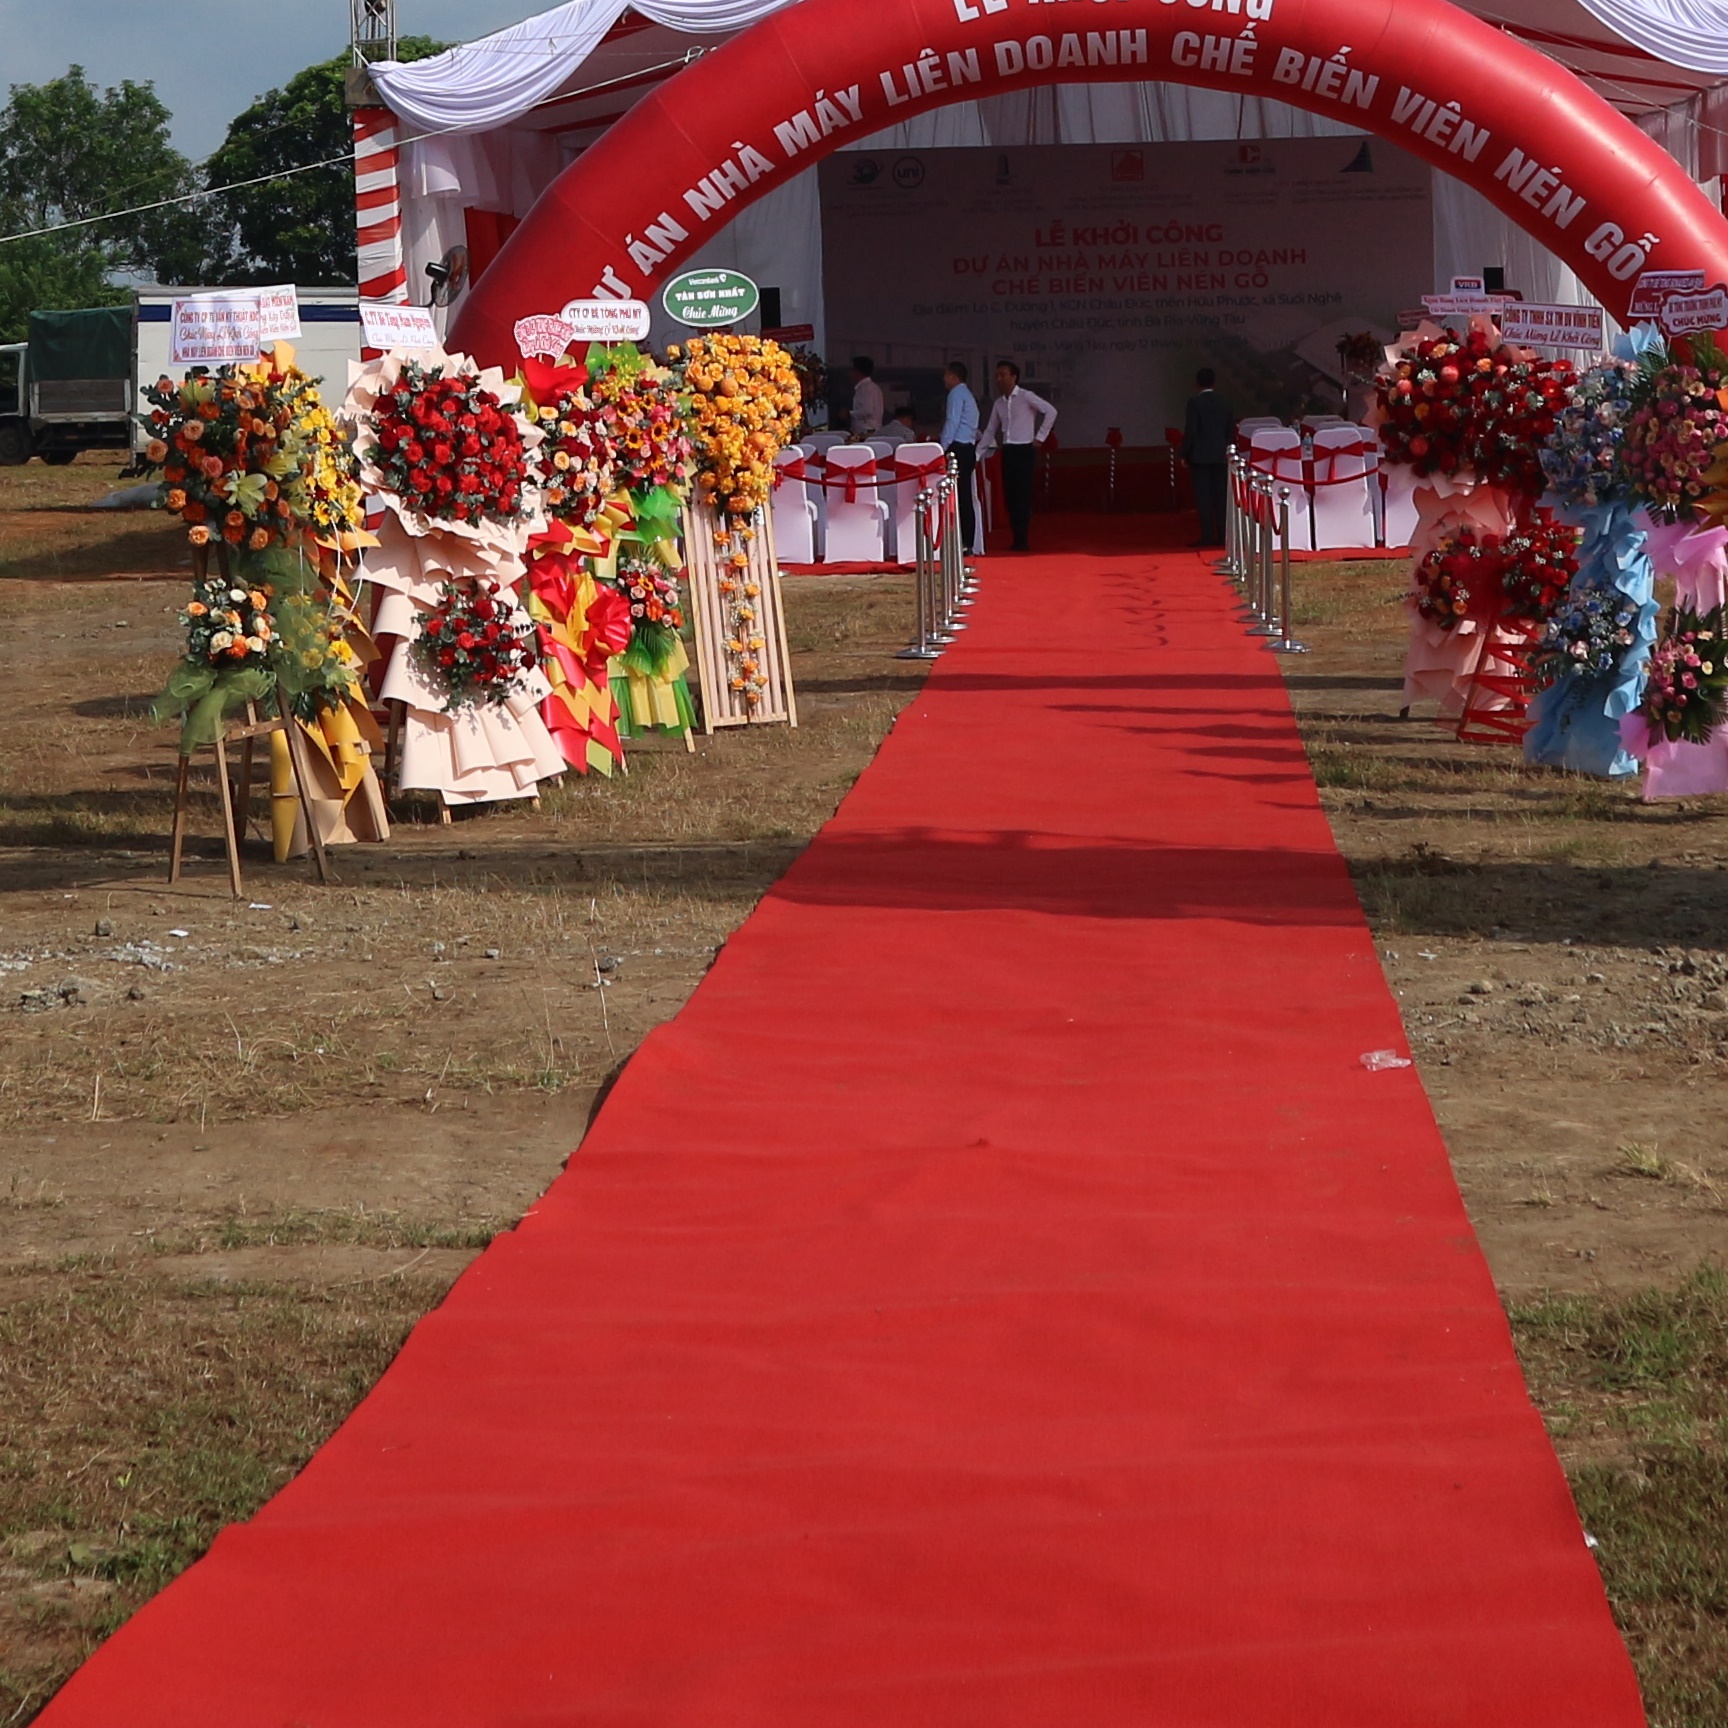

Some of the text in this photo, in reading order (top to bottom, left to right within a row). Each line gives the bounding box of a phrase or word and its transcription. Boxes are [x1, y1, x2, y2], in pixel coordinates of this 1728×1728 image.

[625, 215, 689, 278] ÁN
[682, 140, 775, 221] NHÀ
[772, 89, 864, 158] MÁY
[879, 46, 981, 107] LIÊN
[992, 27, 1148, 77] DOANH
[1171, 22, 1259, 75] CHẾ
[1273, 45, 1380, 109] BIẾN
[1390, 100, 1491, 163] VIÊN
[1494, 147, 1588, 230] NÉN
[1584, 232, 1661, 281] GỖ
[1035, 219, 1225, 247] LỄ KHỞI CÔNG
